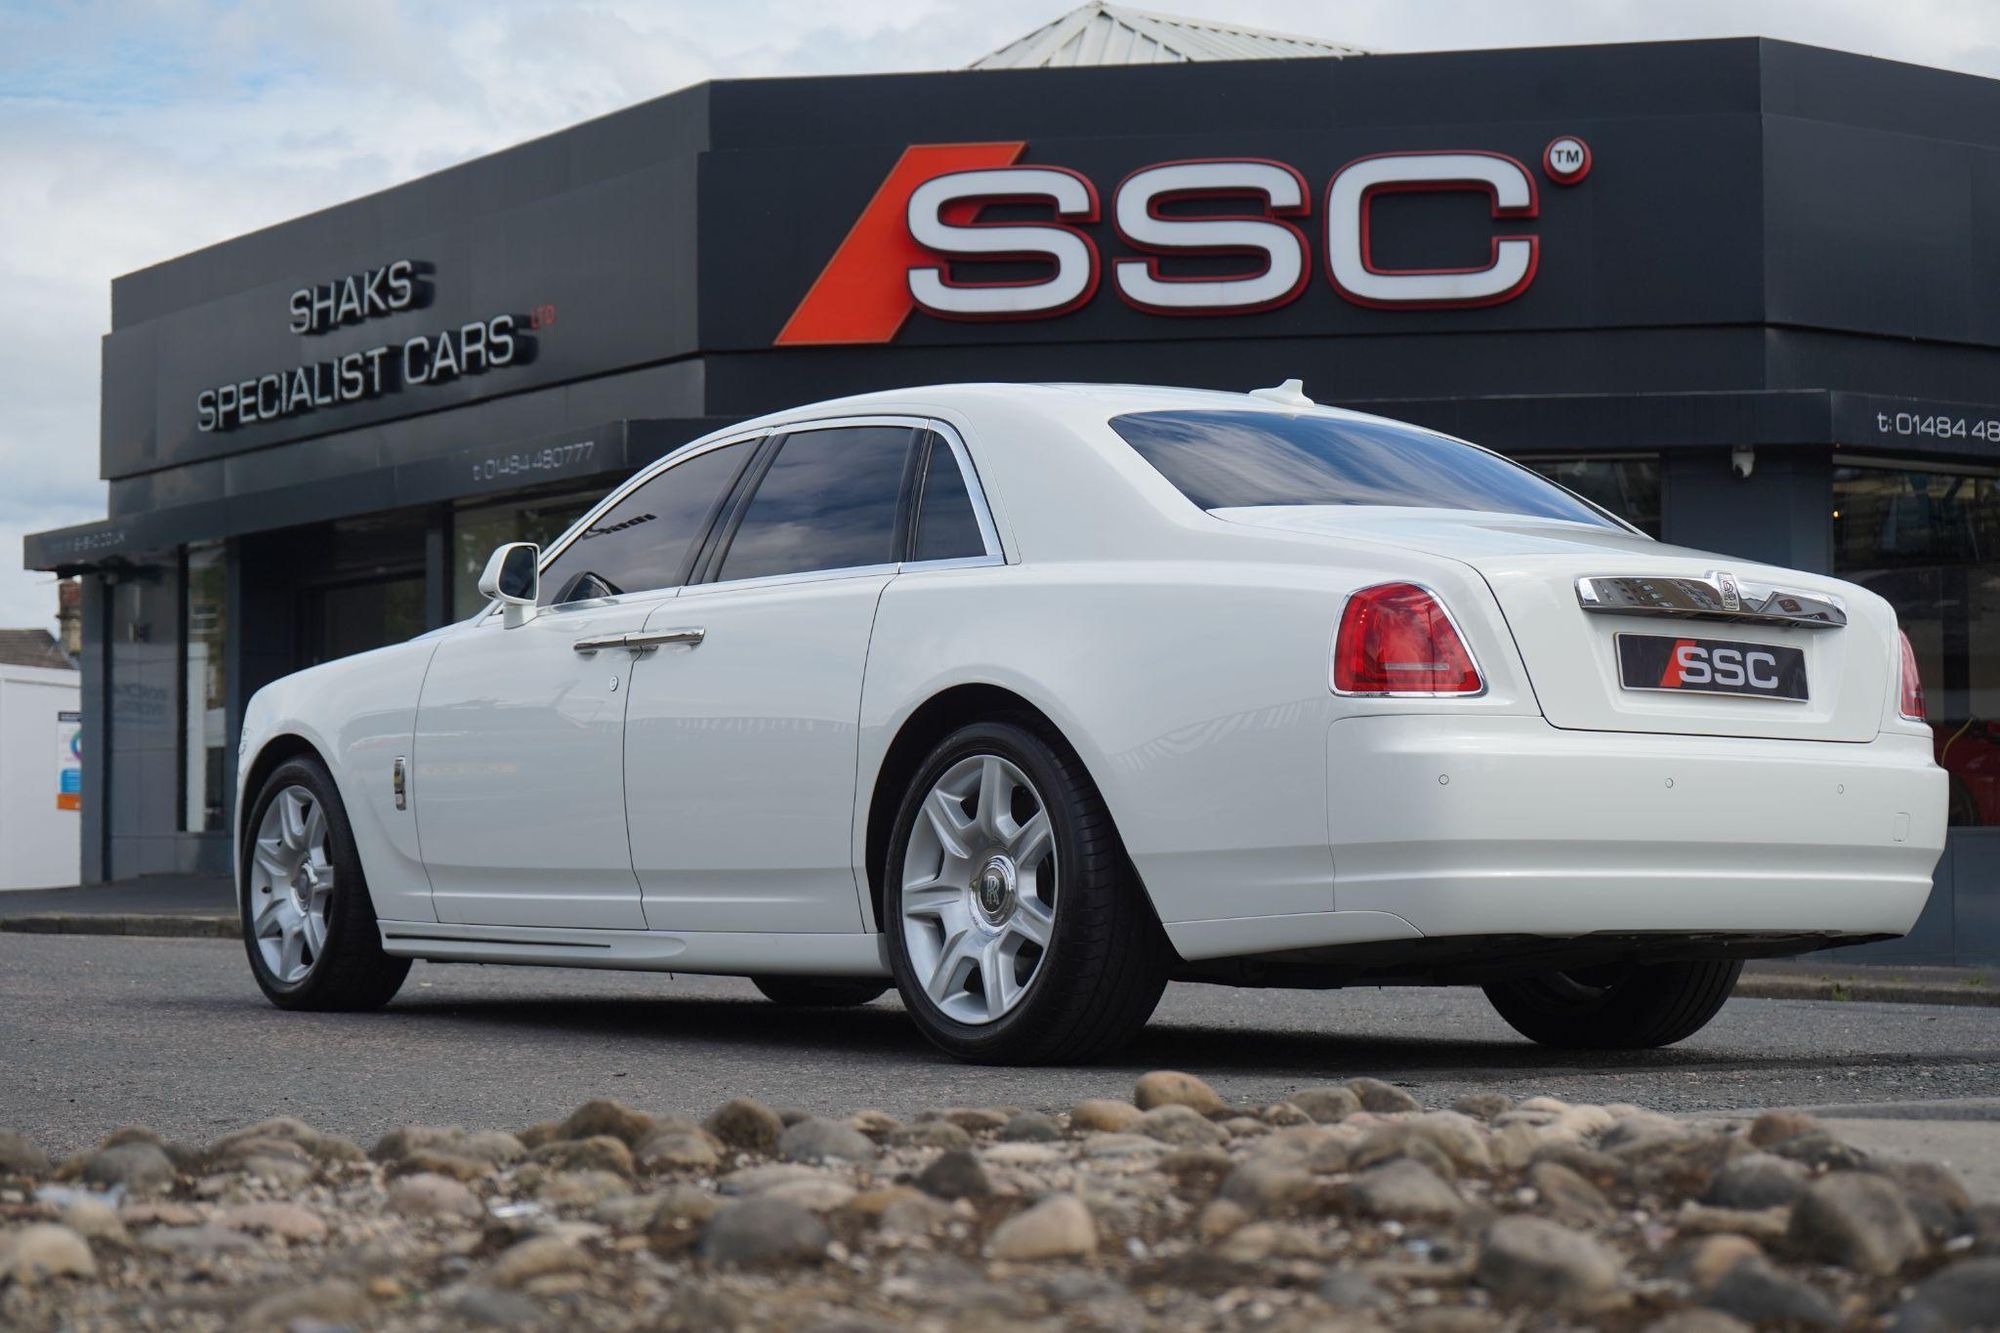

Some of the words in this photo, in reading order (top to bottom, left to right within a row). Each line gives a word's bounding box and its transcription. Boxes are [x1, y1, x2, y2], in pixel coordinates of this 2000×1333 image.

[907, 151, 1538, 316] SSC
[1554, 150, 1579, 163] TM
[289, 259, 414, 334] SHAKS
[197, 345, 390, 432] SPECIALIST
[403, 314, 516, 385] CARS
[1677, 646, 1779, 689] SSC
